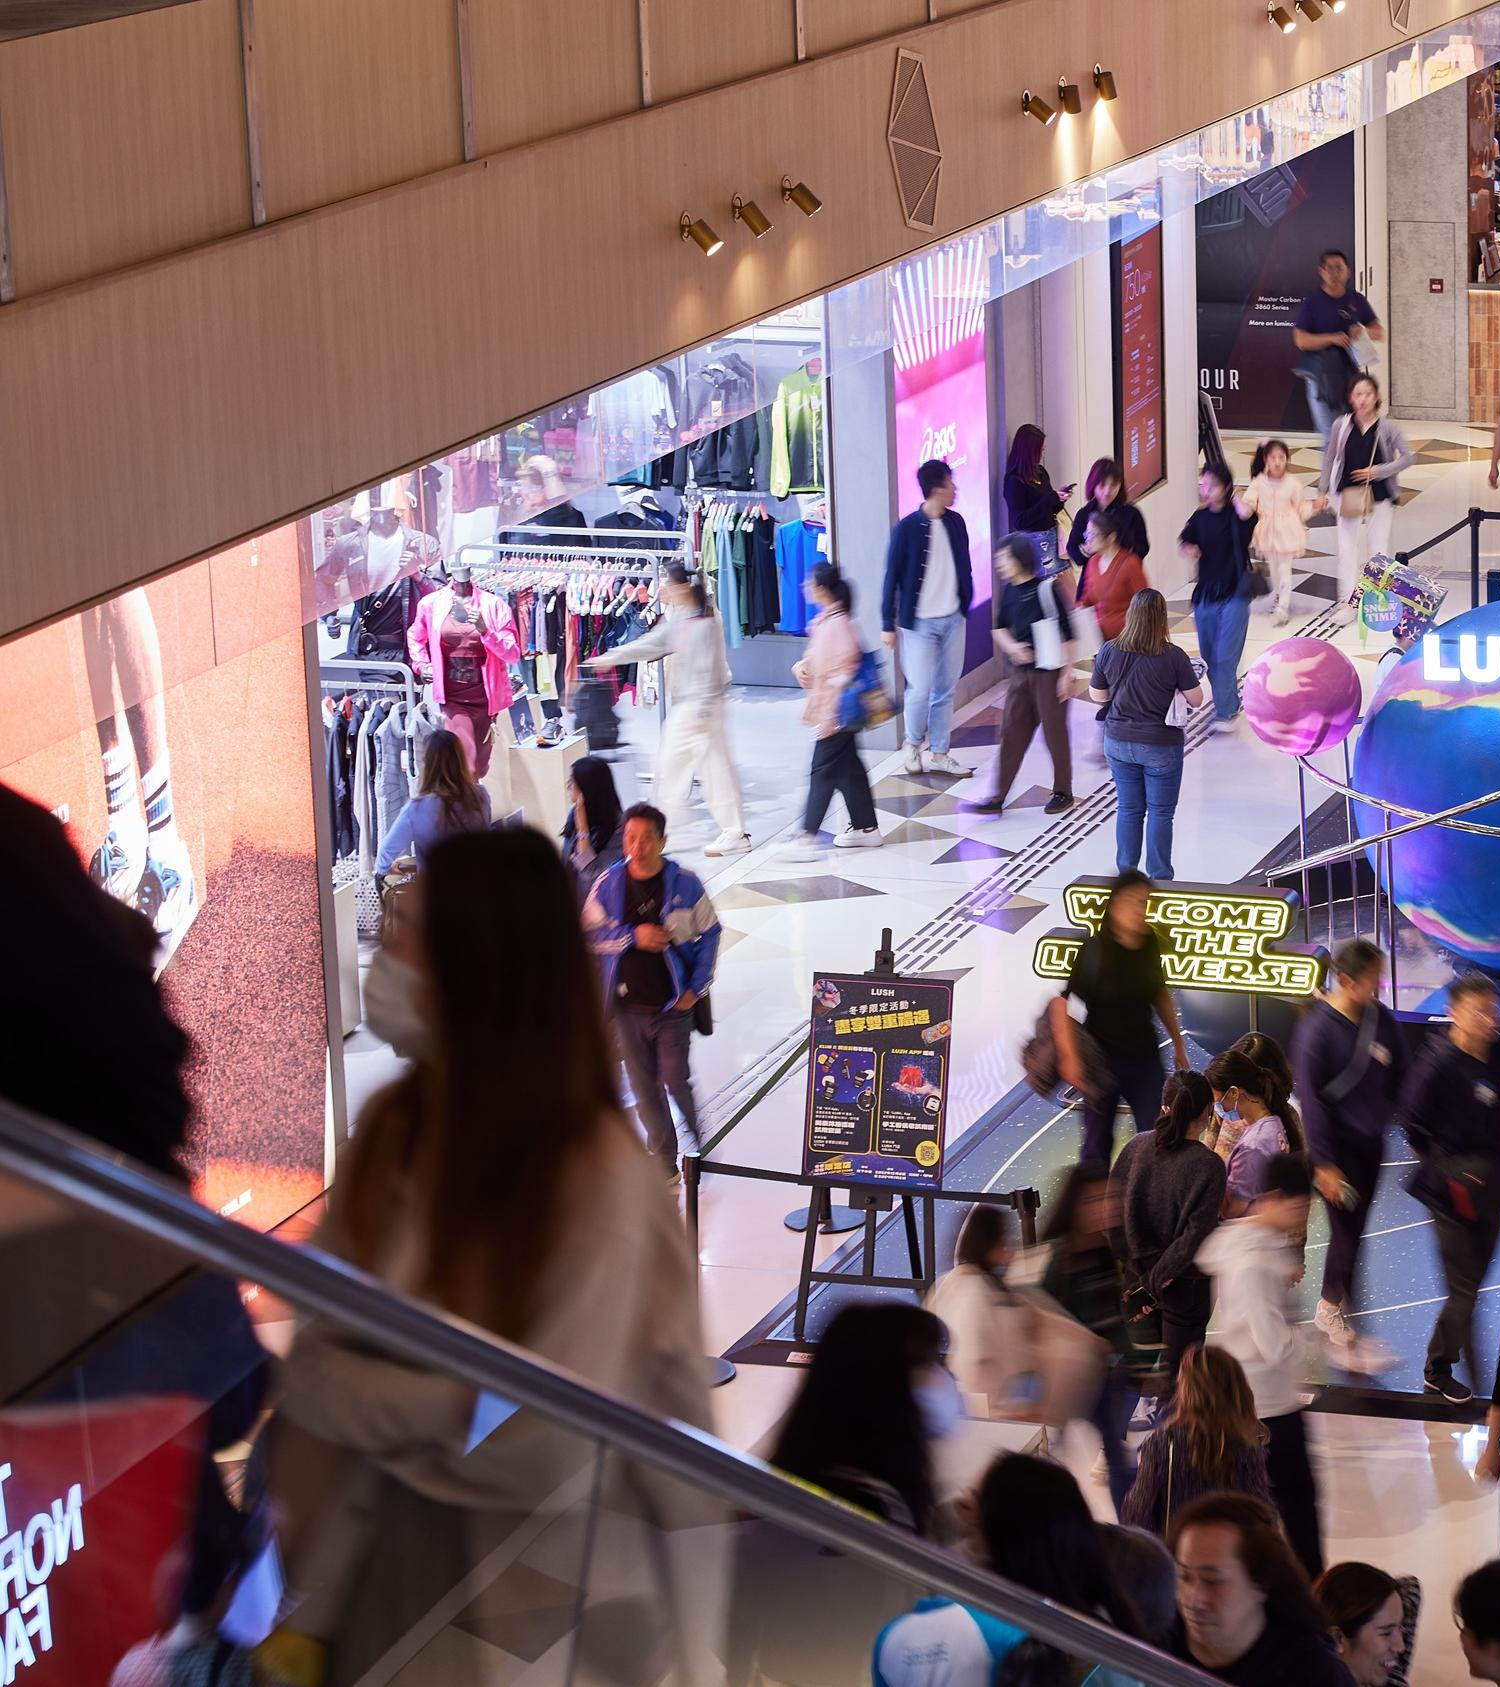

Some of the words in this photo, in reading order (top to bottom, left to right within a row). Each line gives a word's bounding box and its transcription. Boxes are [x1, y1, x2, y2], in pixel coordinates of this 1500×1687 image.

[1366, 611, 1398, 622] TIME
[1071, 893, 1283, 932] WLCOME
[1169, 927, 1258, 957] THE
[871, 988, 895, 997] LUSH
